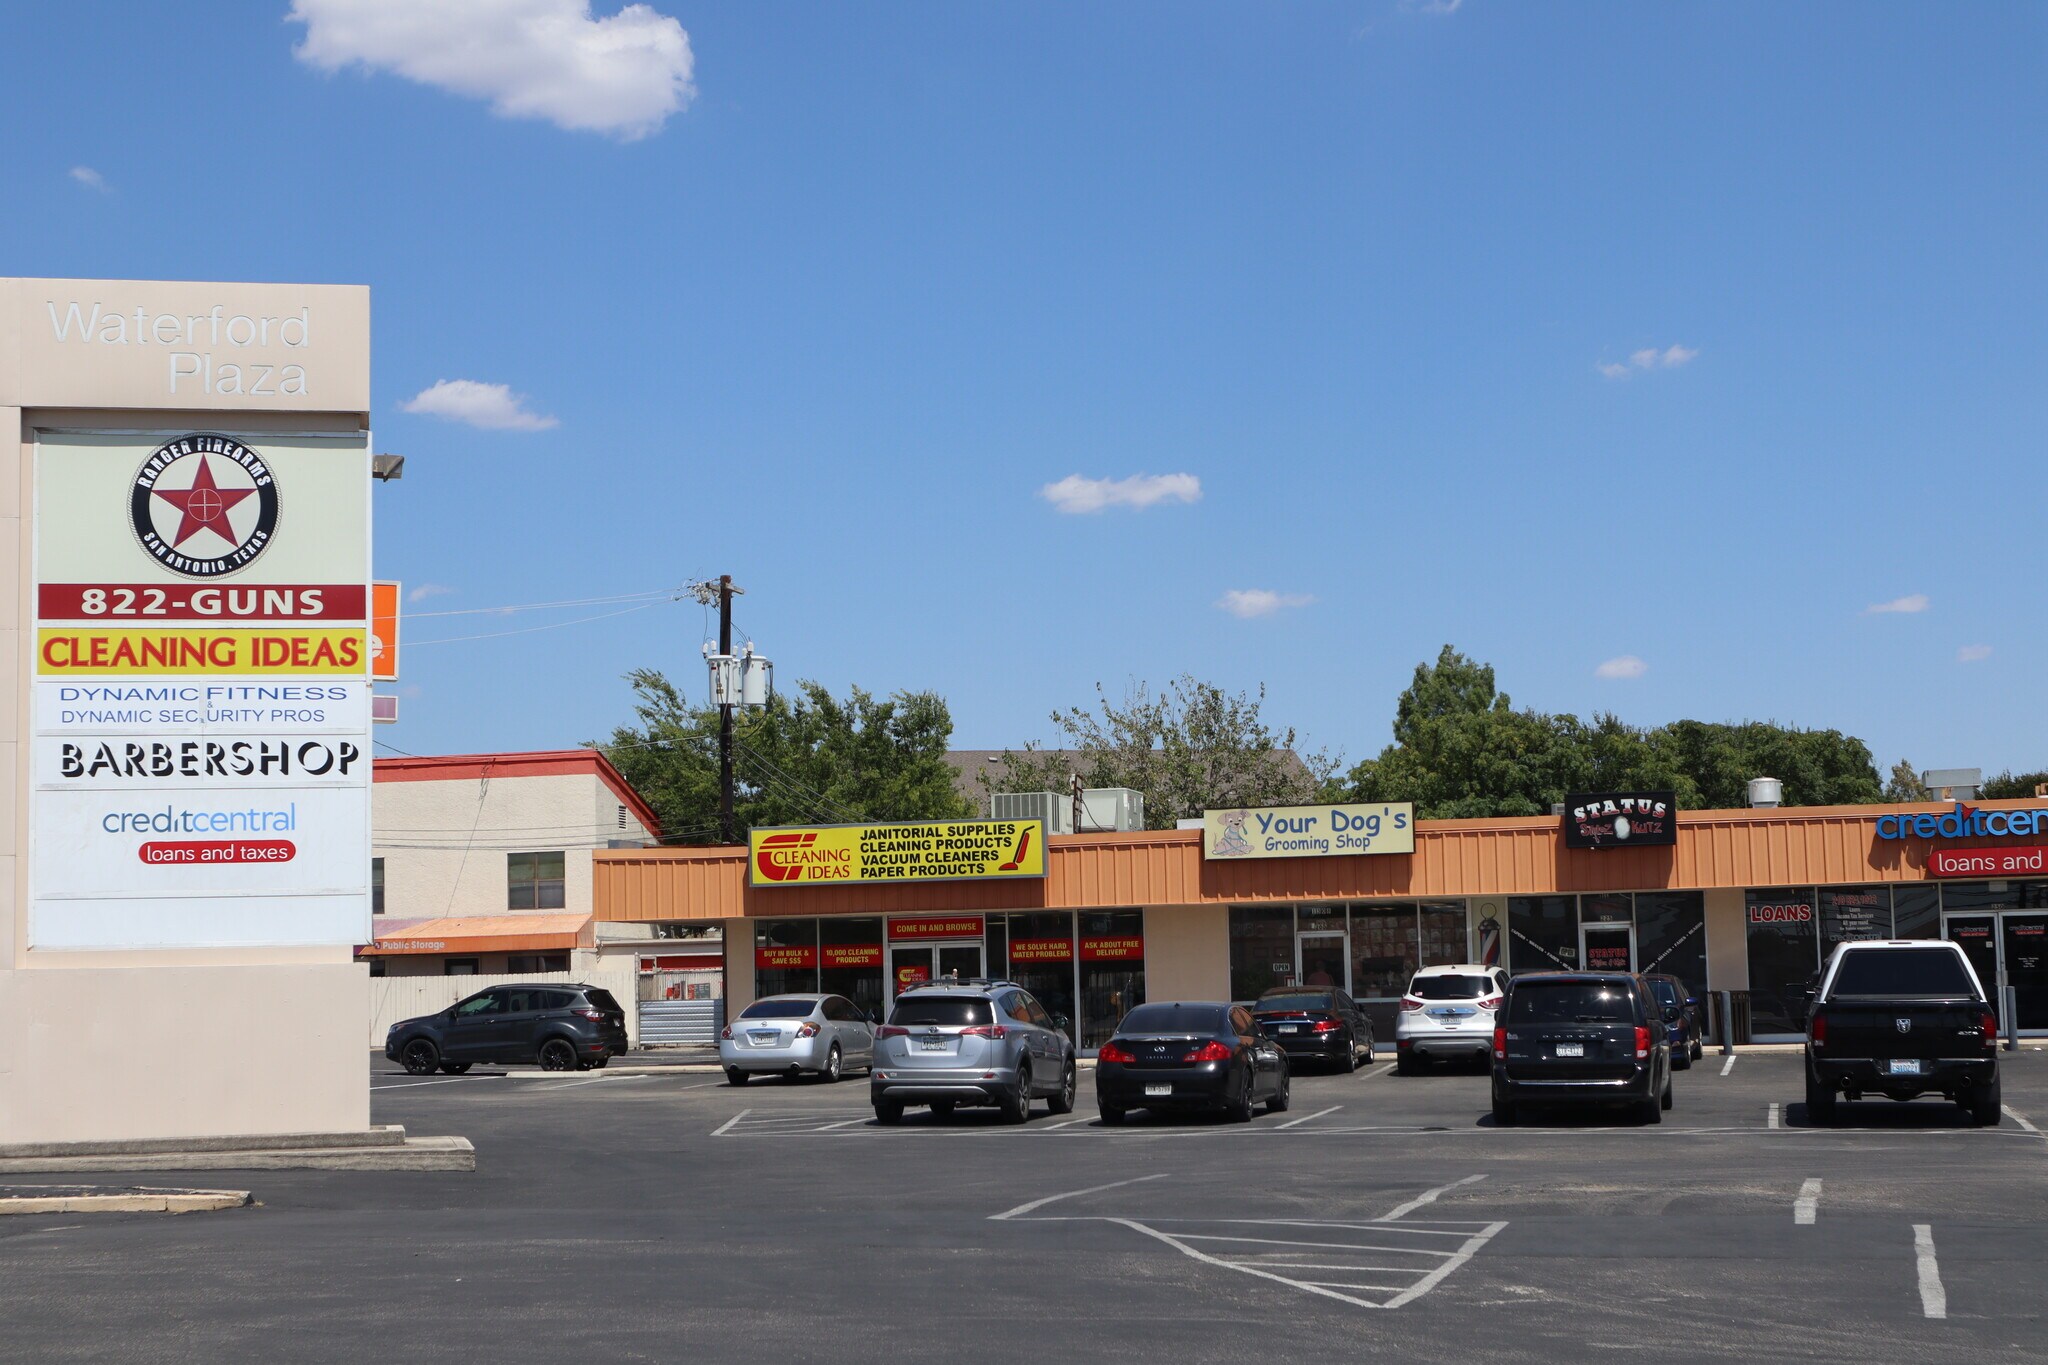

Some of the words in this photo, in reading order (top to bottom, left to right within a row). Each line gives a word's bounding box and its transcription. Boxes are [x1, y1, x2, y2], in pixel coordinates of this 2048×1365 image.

[47, 300, 310, 348] Waterford
[168, 351, 310, 397] Plaza
[137, 440, 191, 488] RANGER
[197, 437, 271, 486] FIREARMS
[144, 532, 164, 556] SAN
[233, 530, 268, 564] TEXAS
[81, 588, 325, 615] 822-GUNS
[42, 637, 237, 668] CLEANING
[60, 687, 200, 702] DYNAMIC
[206, 686, 347, 701] FITNESS
[207, 701, 213, 709] &
[61, 709, 152, 724] DYNAMIC
[270, 709, 325, 723] PROS
[61, 740, 359, 778] BARBERSHOP
[102, 802, 296, 833] creditcentral
[1574, 798, 1667, 823] STATUS
[1255, 812, 1317, 835] Your
[1331, 807, 1407, 837] Dog's
[860, 827, 943, 841] JANITORIAL
[947, 824, 1016, 837] SUPPLIES
[860, 840, 931, 853] CLEANING
[936, 837, 1012, 850] PRODUCTS
[1265, 835, 1329, 853] Grooming
[1336, 833, 1371, 851] Shop
[147, 845, 195, 862] loans
[201, 844, 235, 861] and
[240, 846, 288, 860] taxes
[773, 848, 851, 865] CLEANING
[861, 853, 921, 866] VACUUM
[925, 850, 999, 864] CLEANERS
[1938, 853, 1996, 872] loans
[2002, 850, 2042, 870] and
[808, 865, 850, 879] IDEAS
[861, 866, 905, 878] PAPER
[909, 863, 985, 877] PRODUCTS
[1750, 904, 1812, 923] LOANS
[919, 924, 926, 932] IN
[945, 922, 976, 931] BROWSE
[383, 941, 409, 949] Public
[411, 941, 445, 950] Storage
[826, 949, 846, 957] 10,000
[848, 948, 879, 956] CLEANING
[1588, 947, 1628, 958] STATUS
[1275, 963, 1289, 971] OPEN
